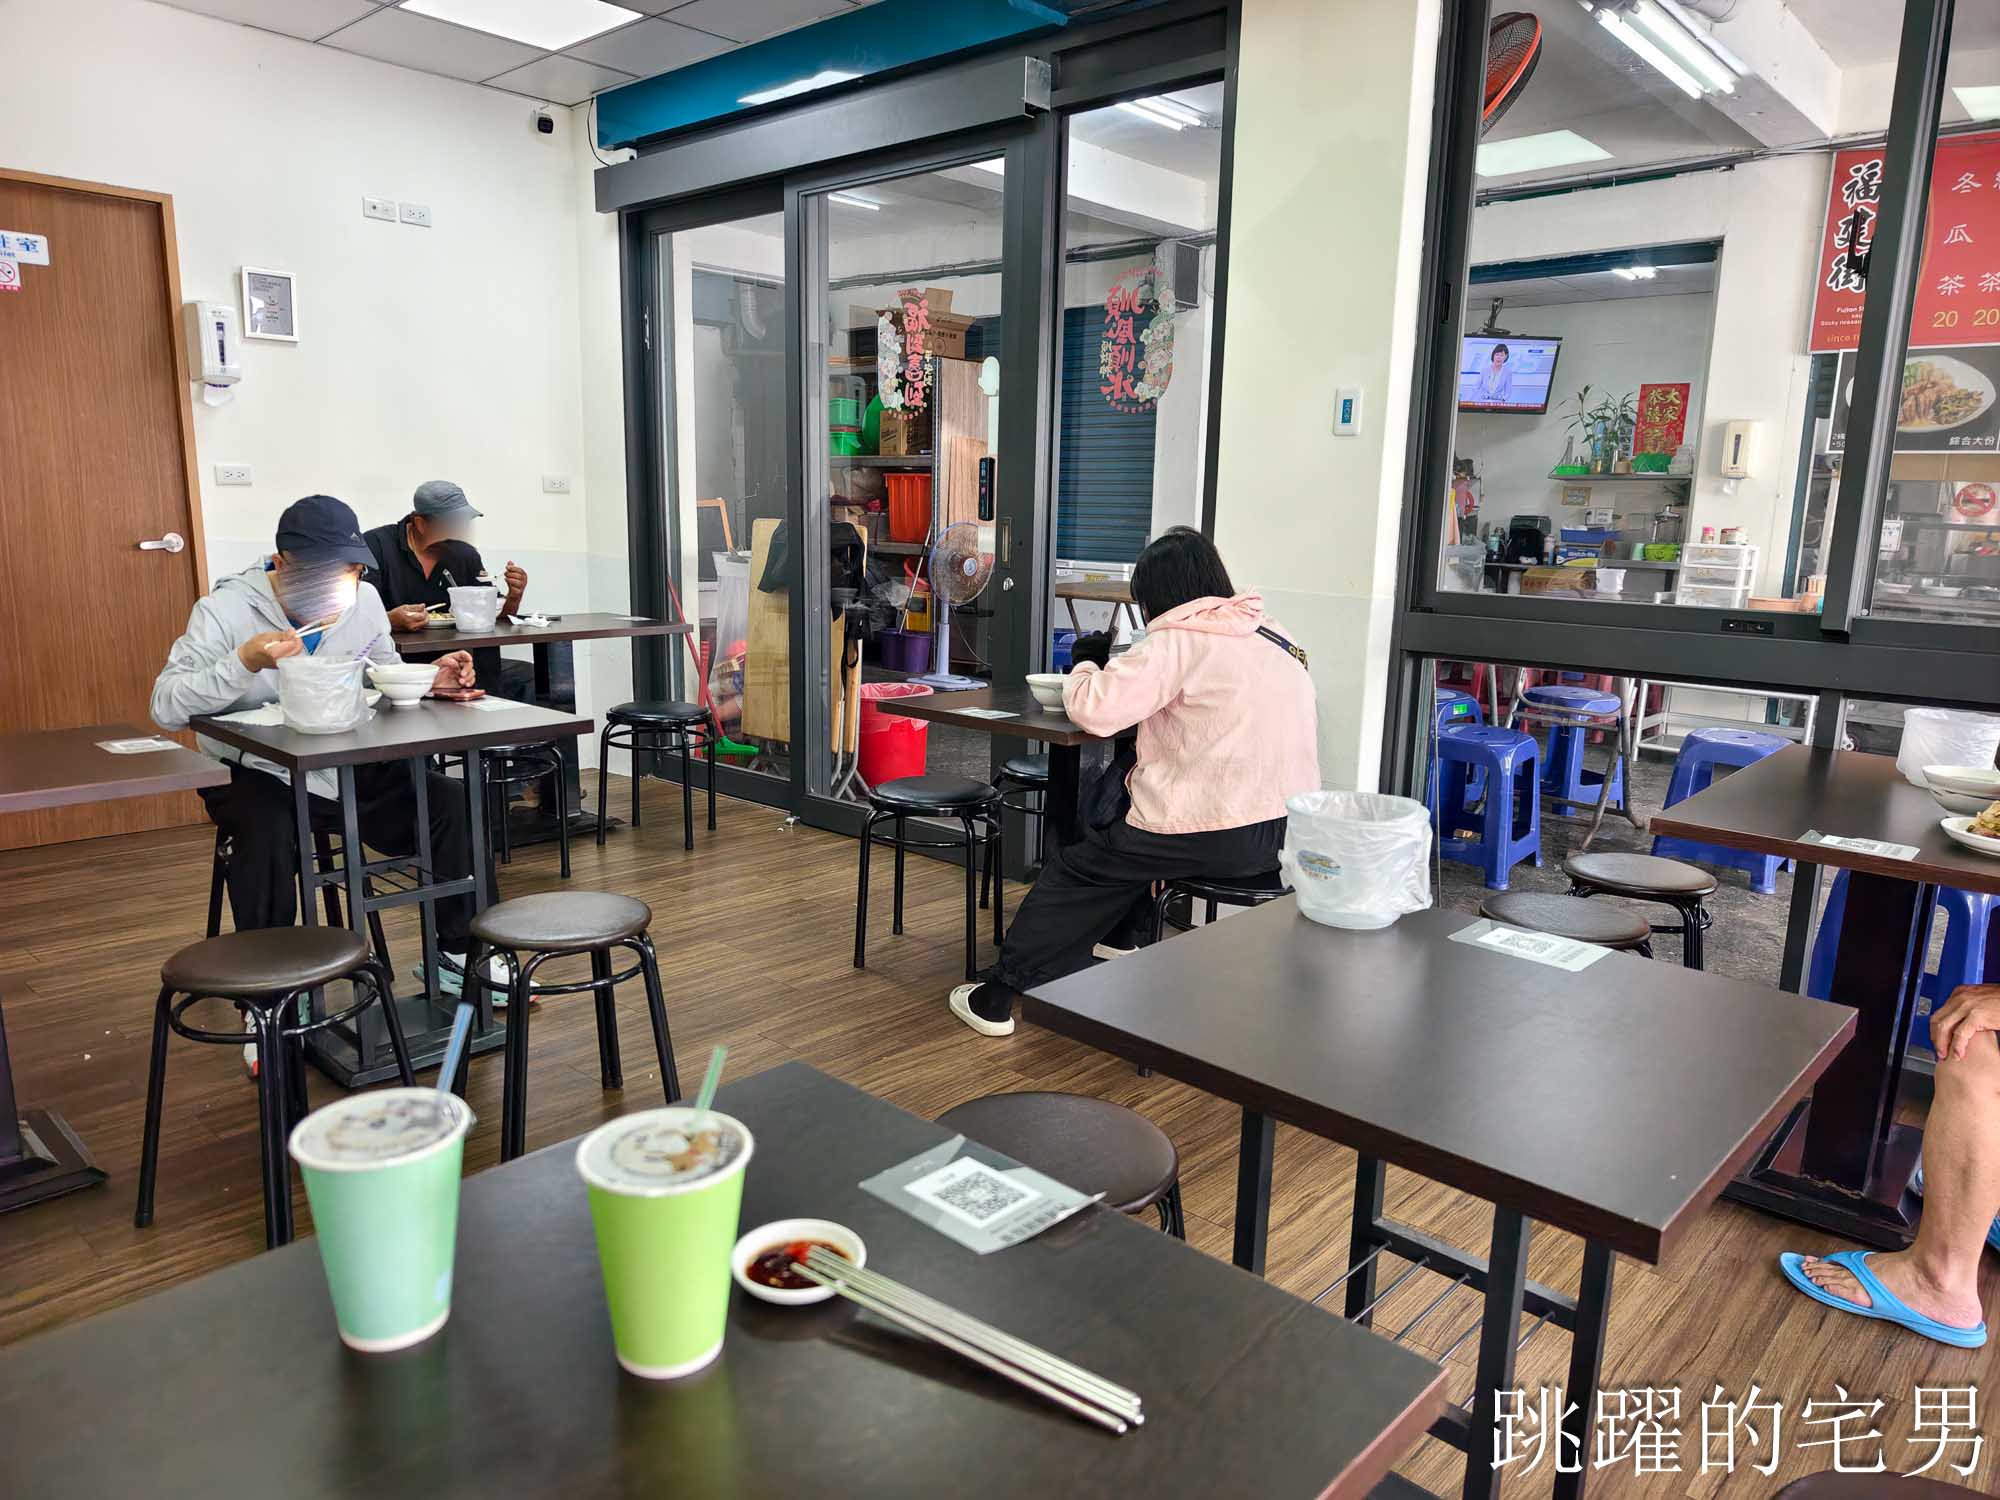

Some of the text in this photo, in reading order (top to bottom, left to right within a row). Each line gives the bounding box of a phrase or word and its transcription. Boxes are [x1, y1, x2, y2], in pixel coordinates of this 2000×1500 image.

[1937, 171, 1982, 296] 冬瓜茶
[1932, 310, 1959, 328] 20
[1973, 308, 2000, 326] 20
